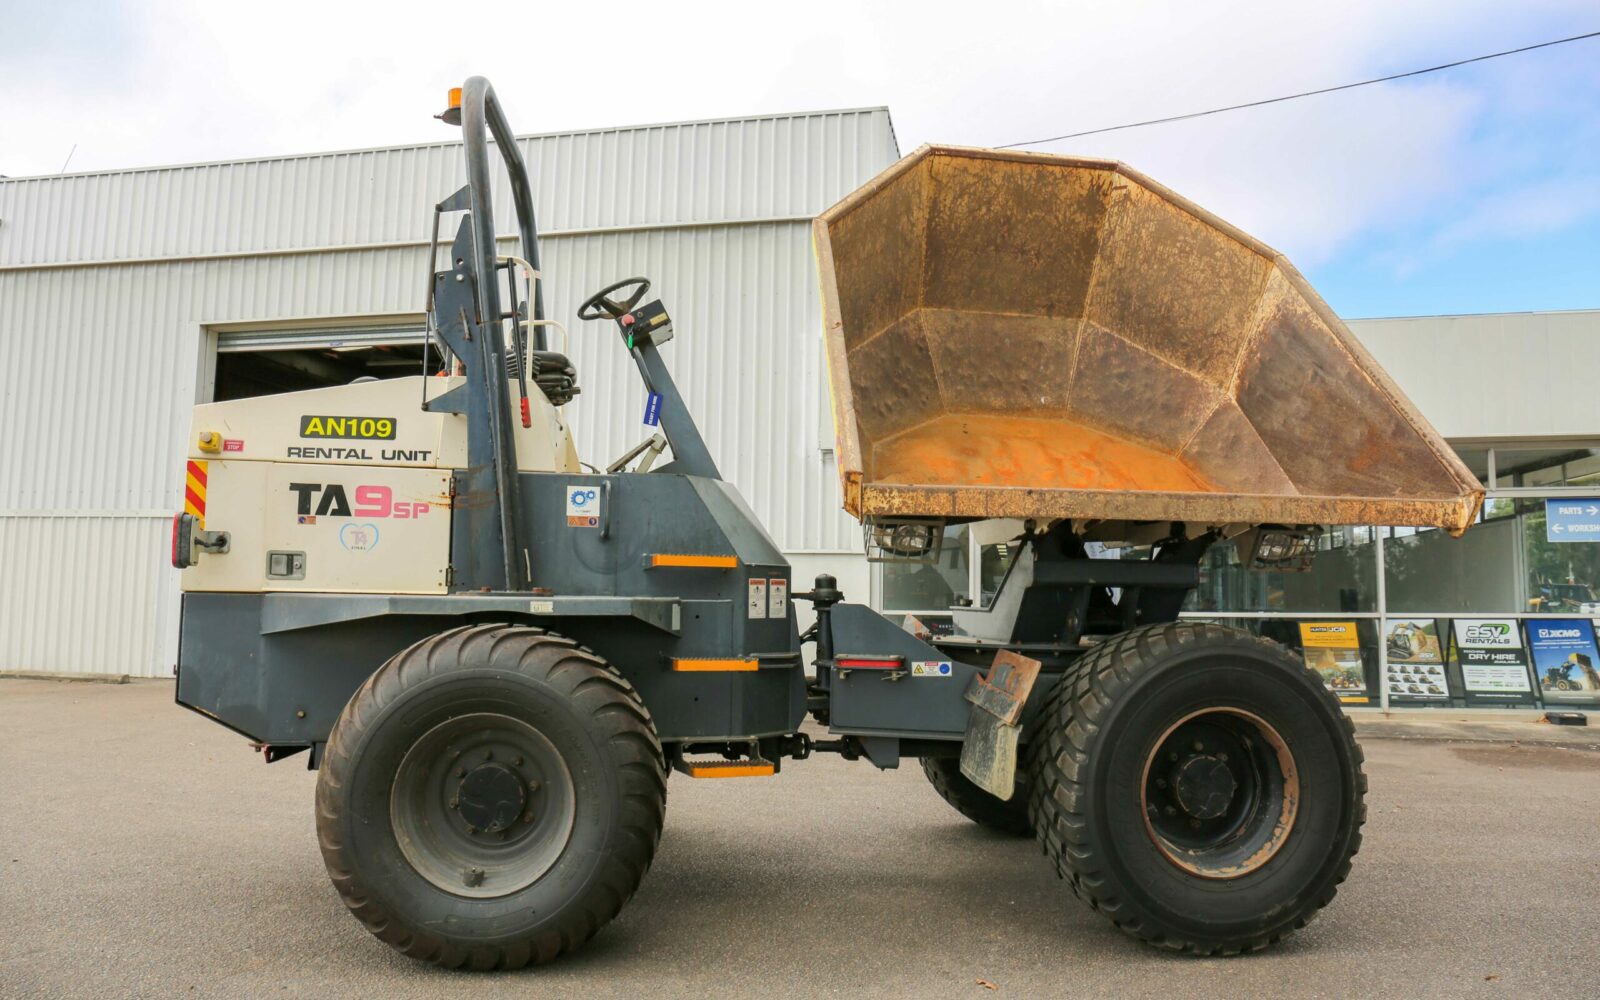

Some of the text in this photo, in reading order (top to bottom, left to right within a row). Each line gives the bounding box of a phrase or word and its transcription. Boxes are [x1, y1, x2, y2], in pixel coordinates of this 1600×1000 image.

[304, 417, 392, 437] AN109
[287, 446, 432, 461] RENTAL UNIT
[1559, 507, 1583, 515] PARTS
[1550, 629, 1581, 637] XCMG
